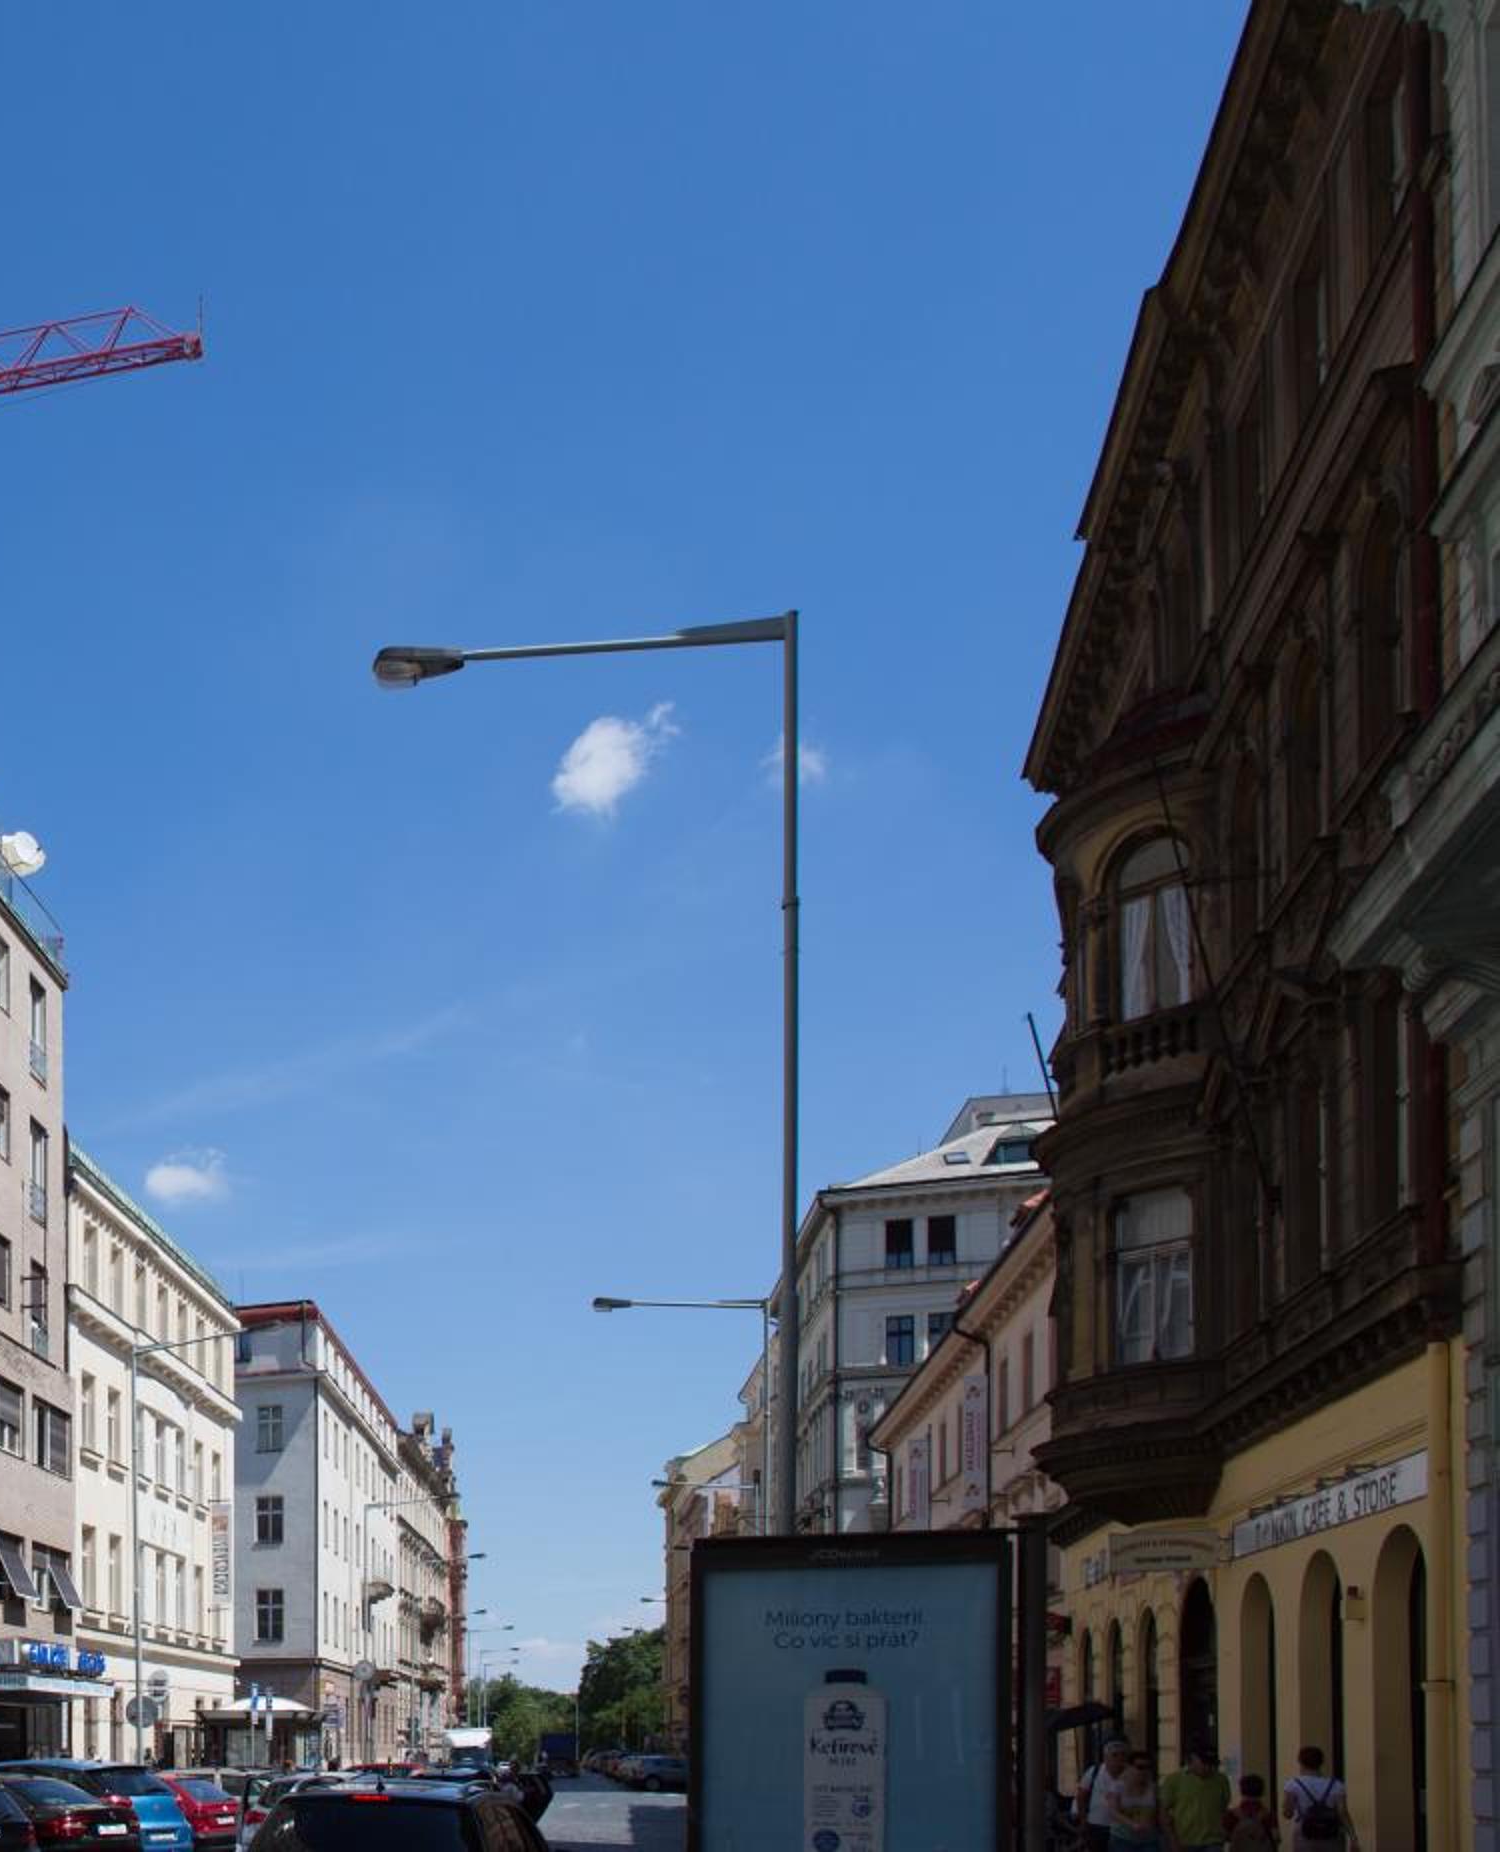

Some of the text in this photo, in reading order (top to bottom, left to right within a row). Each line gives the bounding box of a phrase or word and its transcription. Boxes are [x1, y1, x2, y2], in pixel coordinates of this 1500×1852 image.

[1337, 1490, 1348, 1521] &
[1353, 1471, 1398, 1516] STORE
[764, 1610, 841, 1630] Miliony
[774, 1632, 805, 1649] Co
[844, 1630, 861, 1649] si
